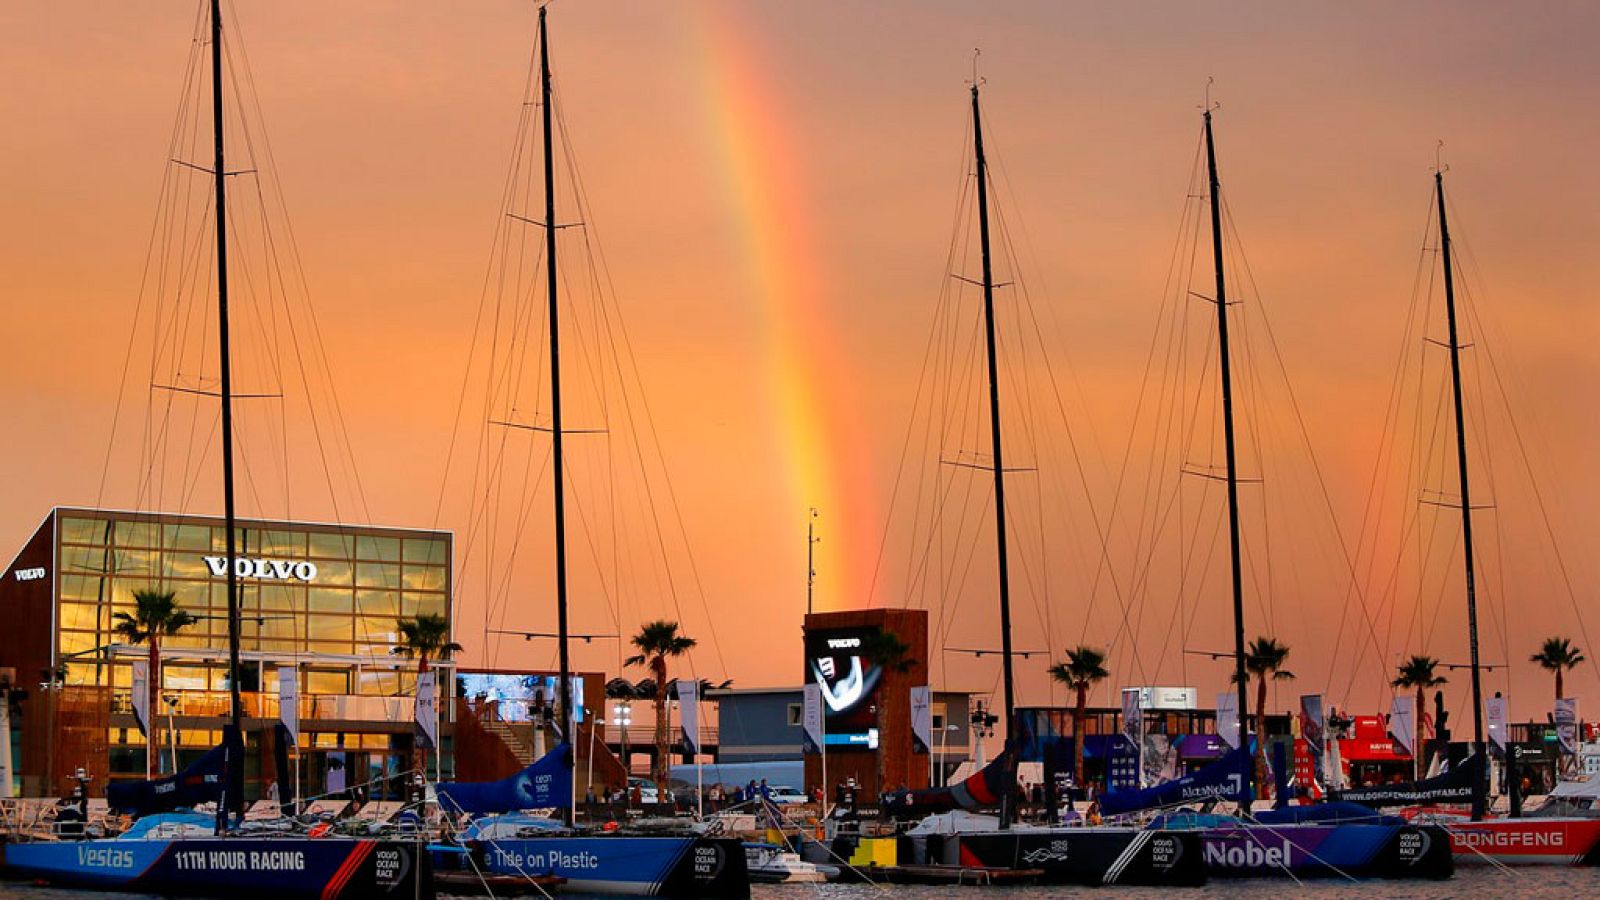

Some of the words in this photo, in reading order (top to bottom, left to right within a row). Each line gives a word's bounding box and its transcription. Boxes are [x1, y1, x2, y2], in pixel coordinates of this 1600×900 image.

[15, 567, 46, 581] VOLVO
[203, 556, 317, 581] VOLVO
[1454, 832, 1564, 847] DONGFENG
[78, 846, 134, 868] Vestas
[175, 852, 206, 869] 11TH
[209, 852, 247, 869] HOUR
[251, 852, 305, 870] RACING
[376, 851, 399, 860] VOLVO
[494, 849, 523, 867] Tide
[527, 854, 544, 868] on
[549, 849, 598, 869] Plastic
[376, 861, 400, 869] OCEAN
